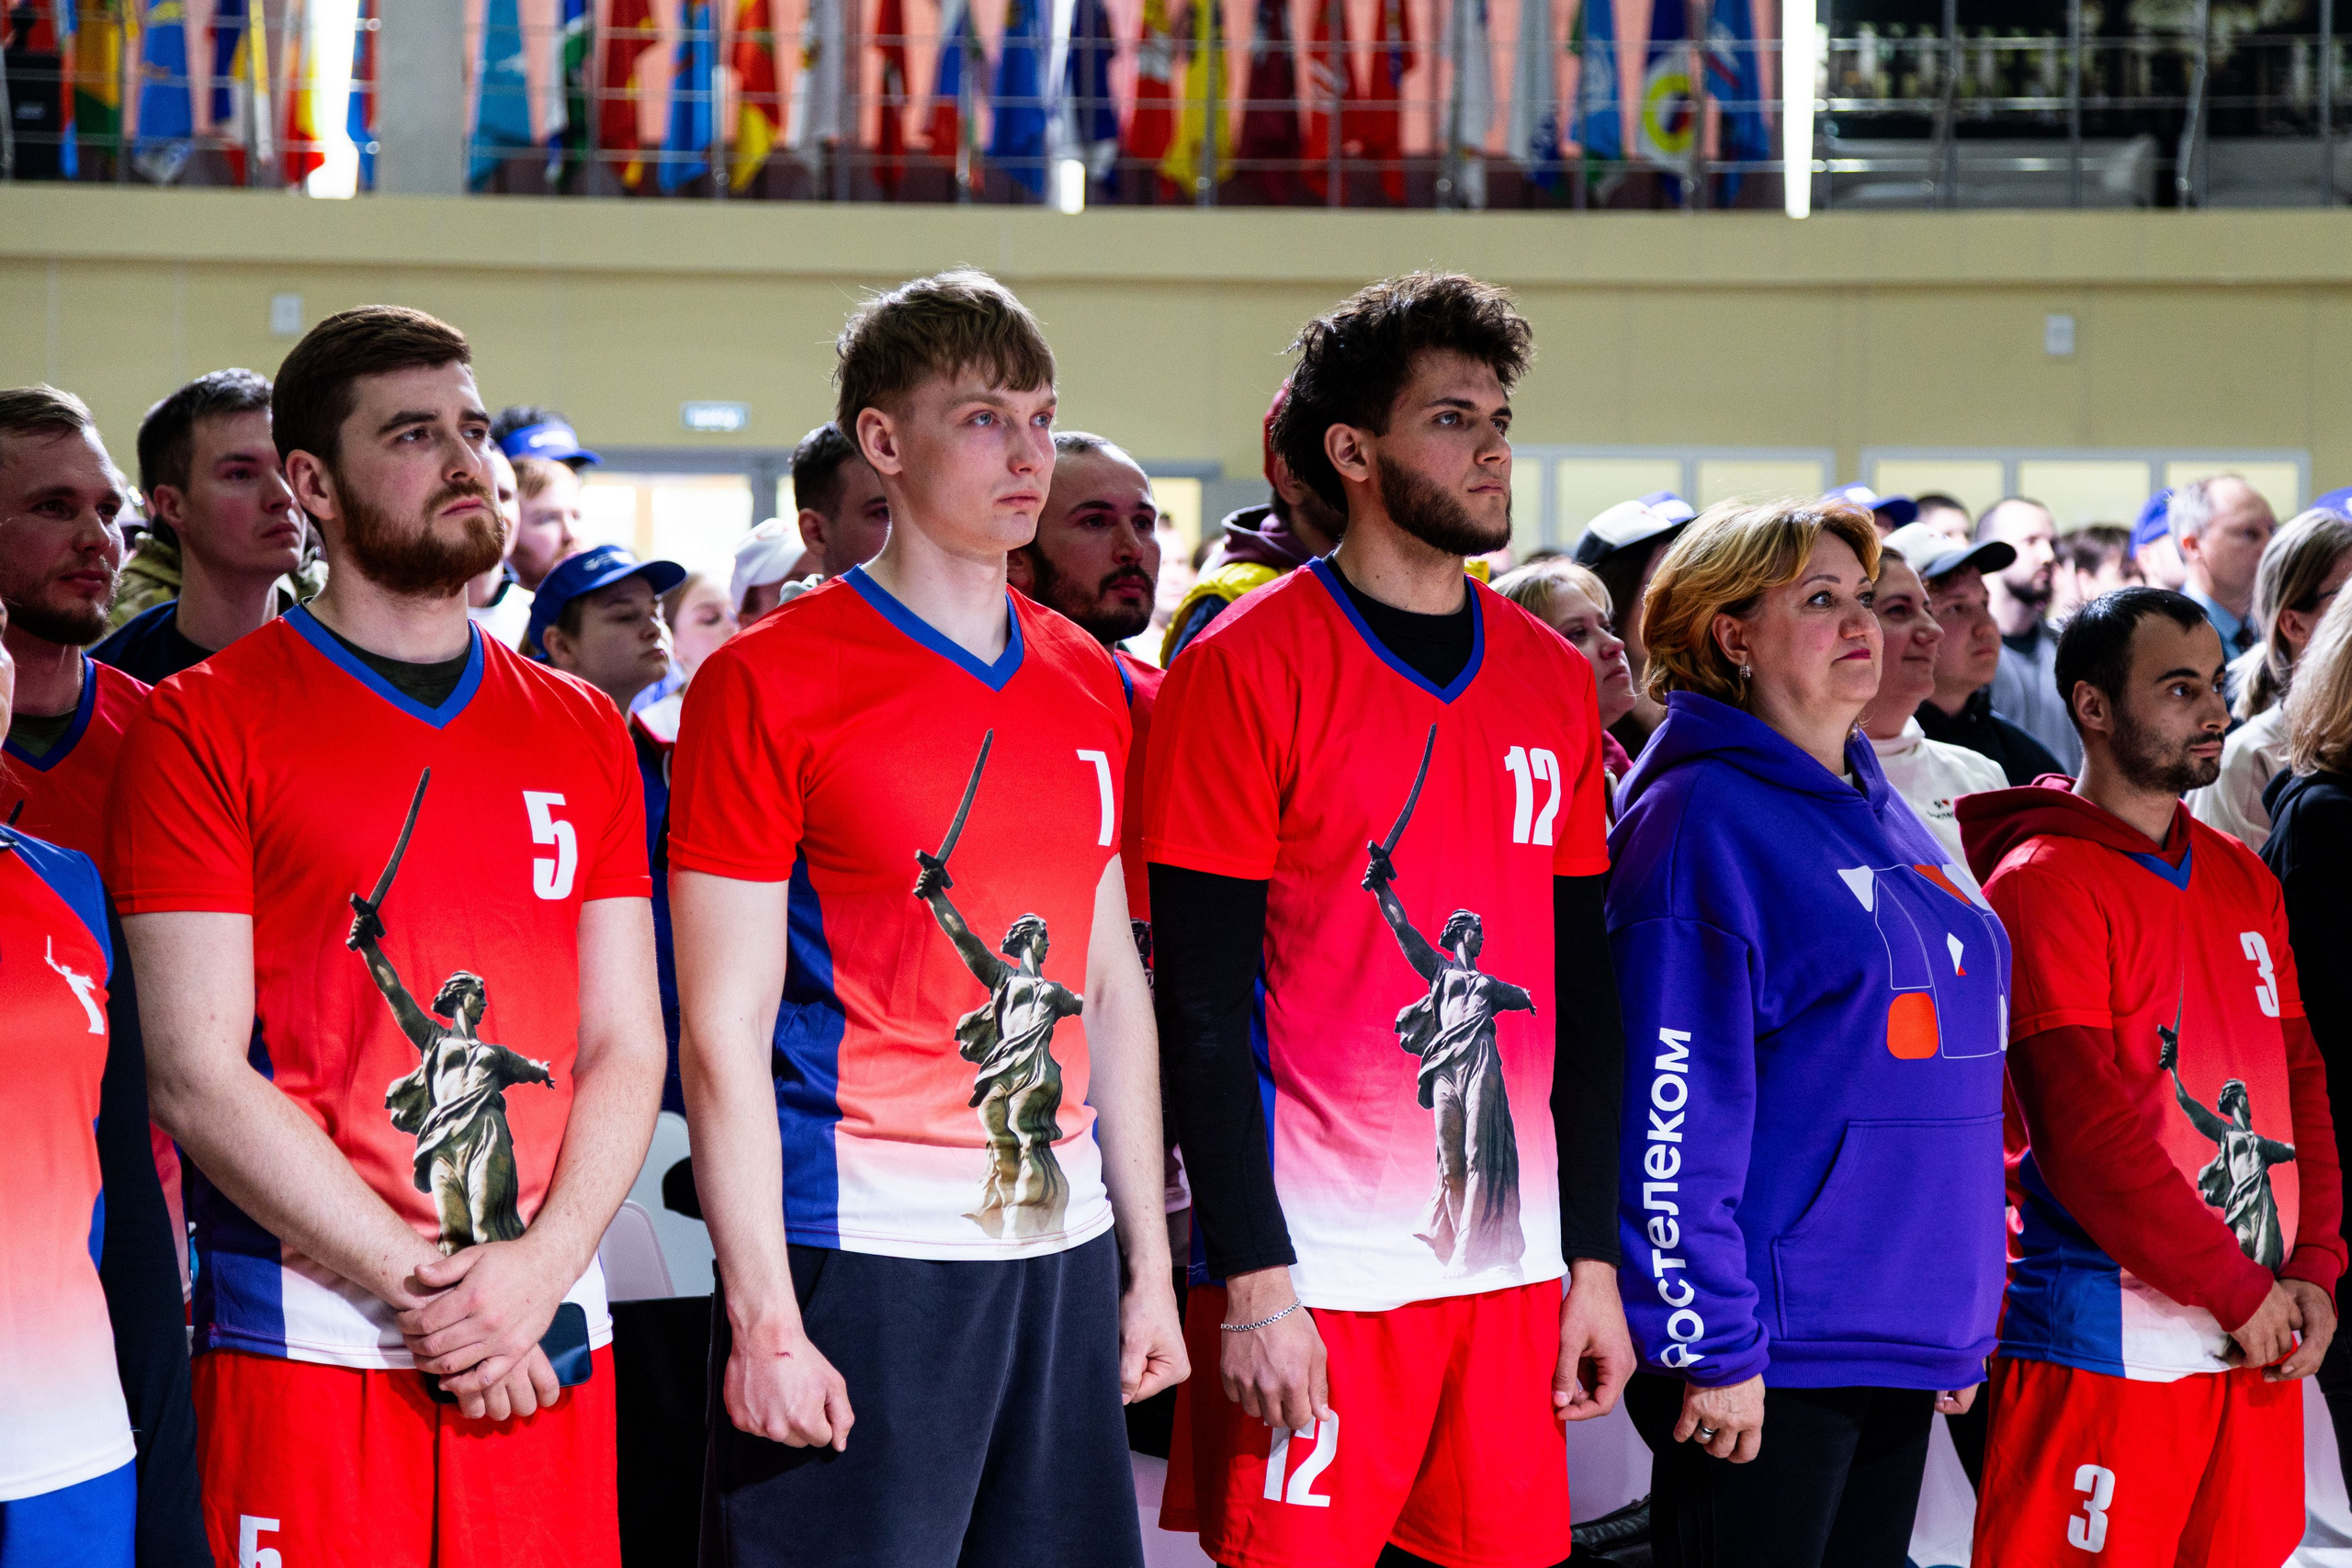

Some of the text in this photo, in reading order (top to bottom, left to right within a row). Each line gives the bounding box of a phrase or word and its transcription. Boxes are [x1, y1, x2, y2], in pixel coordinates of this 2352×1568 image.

[1076, 749, 1114, 847] 7
[1504, 745, 1561, 846] 12
[522, 790, 578, 900] 5
[2240, 931, 2280, 1017] 3
[1263, 1408, 1340, 1507] 12
[2067, 1463, 2116, 1553] 3
